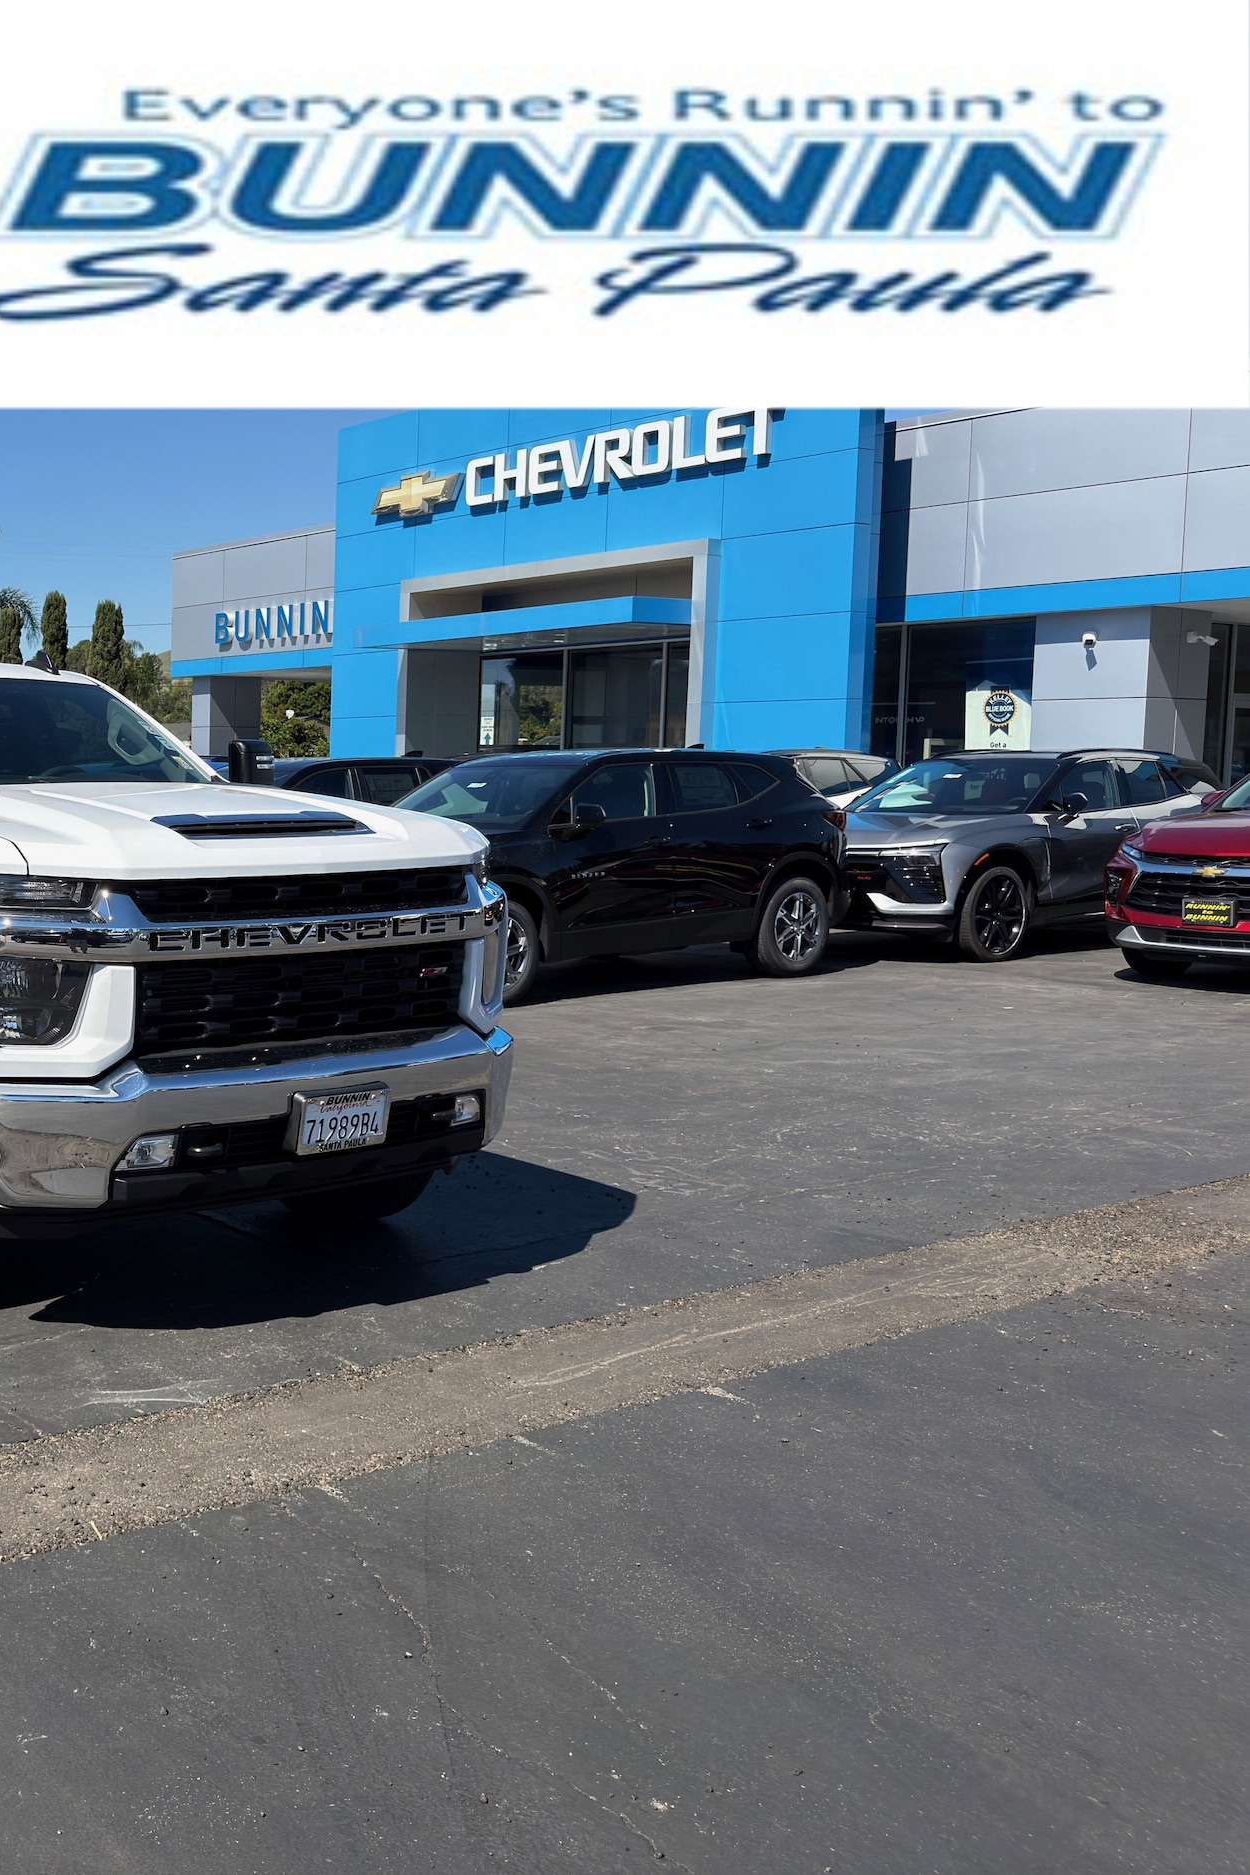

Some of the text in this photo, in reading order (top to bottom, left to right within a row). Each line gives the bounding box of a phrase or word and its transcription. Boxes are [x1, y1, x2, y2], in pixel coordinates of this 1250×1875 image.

[464, 408, 774, 506] CHEVROLET
[214, 599, 331, 645] BUNNIN
[989, 694, 1012, 704] KELLEY
[1185, 903, 1231, 911] RUNNIN'
[148, 909, 482, 952] CHEVROLET
[326, 1092, 371, 1106] BUNNIN
[306, 1110, 380, 1144] 71989B4
[344, 1138, 367, 1149] PAULA
